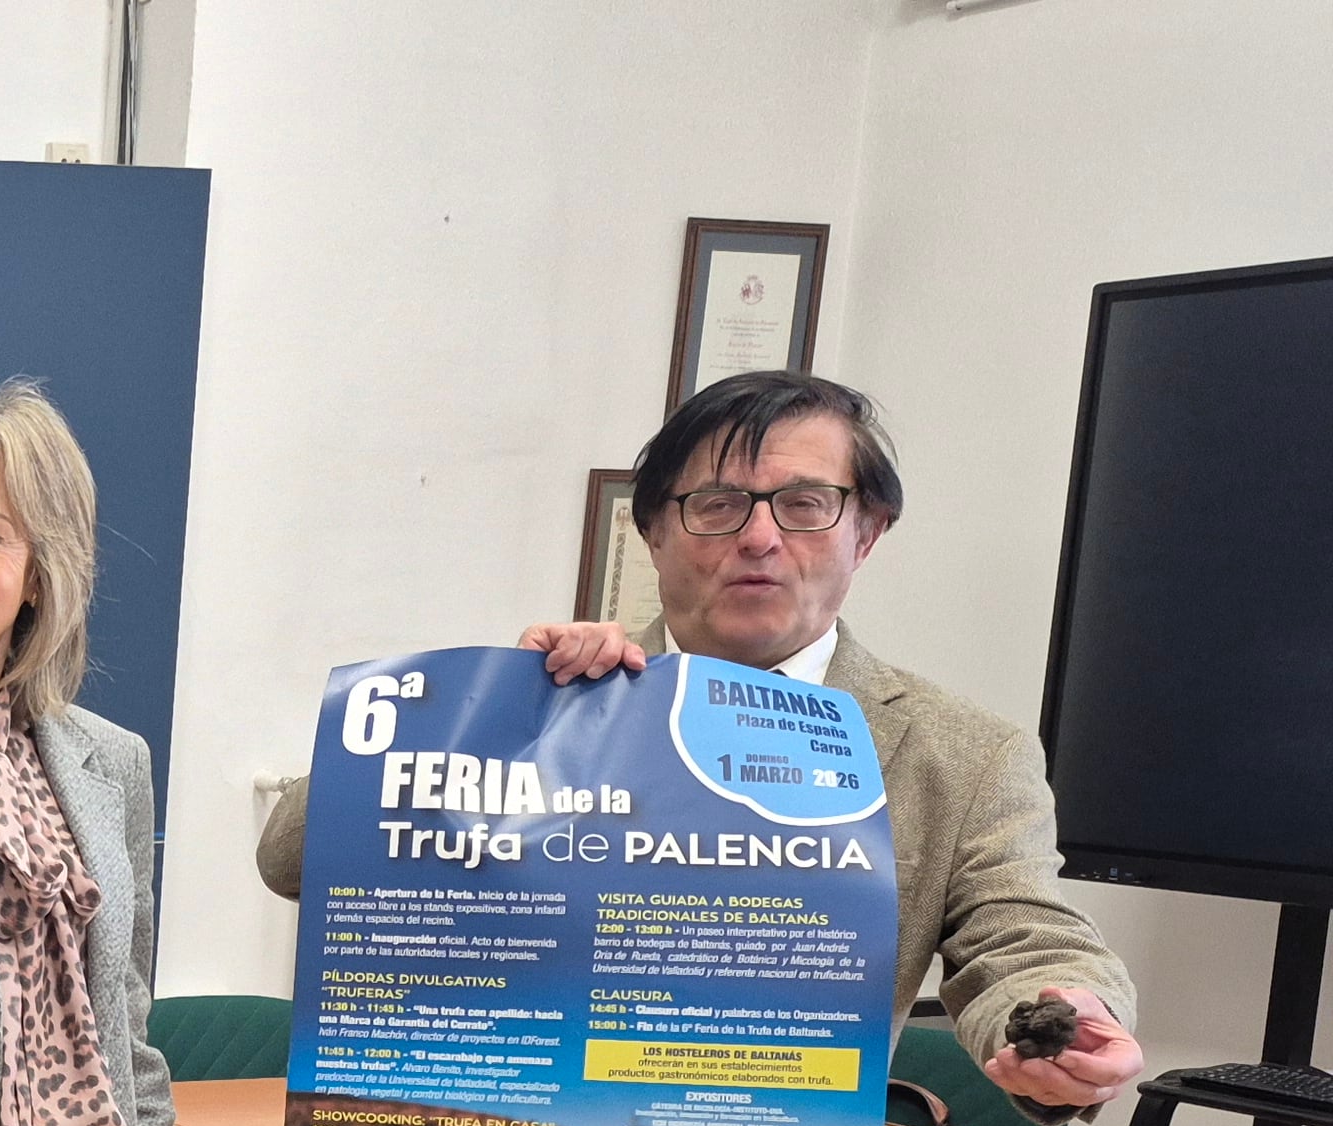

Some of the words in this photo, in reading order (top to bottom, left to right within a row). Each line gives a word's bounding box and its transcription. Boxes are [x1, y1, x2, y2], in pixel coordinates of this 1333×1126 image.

[707, 678, 843, 723] BALTANÁS
[342, 671, 425, 755] 6ª
[736, 713, 775, 729] Plaza
[778, 717, 796, 732] de
[798, 720, 848, 740] España
[810, 738, 852, 757] Carpa
[745, 753, 789, 764] DOMINGO
[717, 753, 732, 782] 1
[740, 764, 803, 785] MARZO
[812, 768, 860, 790] 2026
[381, 751, 546, 815] FERIA
[552, 786, 594, 813] de
[600, 784, 631, 814] la
[379, 821, 522, 869] Trufa
[542, 823, 609, 862] de
[624, 831, 873, 871] PALENCIA
[597, 893, 645, 905] VISITA
[650, 895, 709, 907] GUIADA
[712, 896, 724, 907] A
[729, 896, 803, 909] BODEGAS
[597, 908, 719, 923] TRADICIONALES
[723, 911, 743, 923] DE
[749, 911, 829, 926] BALTANÁS
[322, 968, 394, 984] PÍLDORAS
[399, 973, 507, 988] DIVULGATIVAS
[590, 988, 673, 1002] CLAUSURA
[643, 1047, 662, 1056] LOS
[665, 1048, 731, 1059] HOSTELEROS
[734, 1050, 748, 1059] DE
[751, 1050, 803, 1061] BALTANÁS
[638, 1058, 683, 1068] ofrecerán
[687, 1061, 699, 1069] en
[720, 1061, 803, 1073] establecimientos
[608, 1068, 656, 1080] productos
[658, 1071, 729, 1083] gastronómicos
[732, 1072, 785, 1083] elaborados
[787, 1076, 805, 1084] con
[808, 1075, 834, 1085] trufa.
[312, 1110, 426, 1126] SHOWCOOKING:
